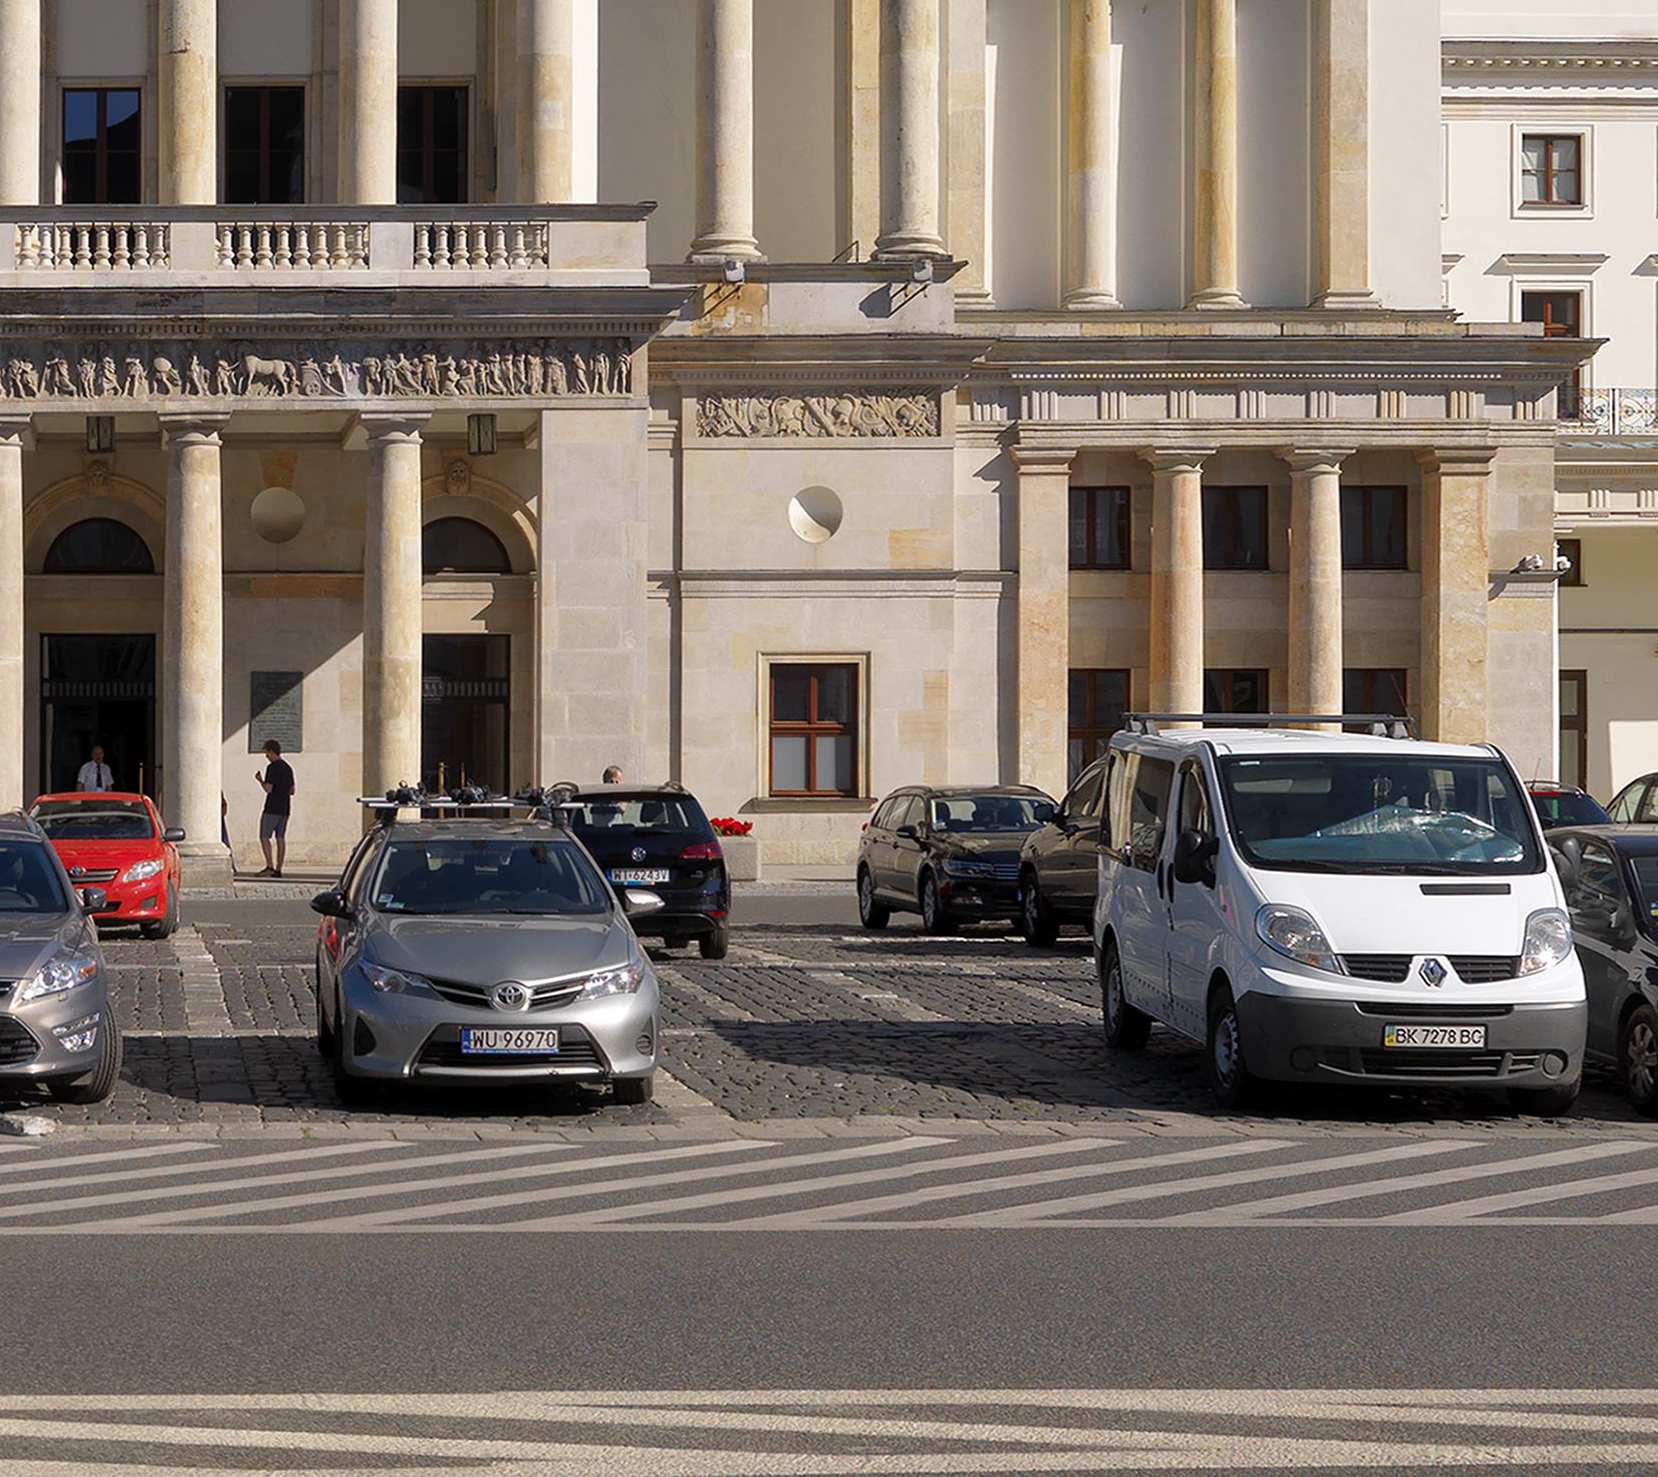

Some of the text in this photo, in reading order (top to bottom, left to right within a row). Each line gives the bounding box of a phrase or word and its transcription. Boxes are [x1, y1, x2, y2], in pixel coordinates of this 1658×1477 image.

[471, 1030, 556, 1048] WU 96970
[1395, 1028, 1417, 1044] BK
[1422, 1029, 1456, 1044] 7278
